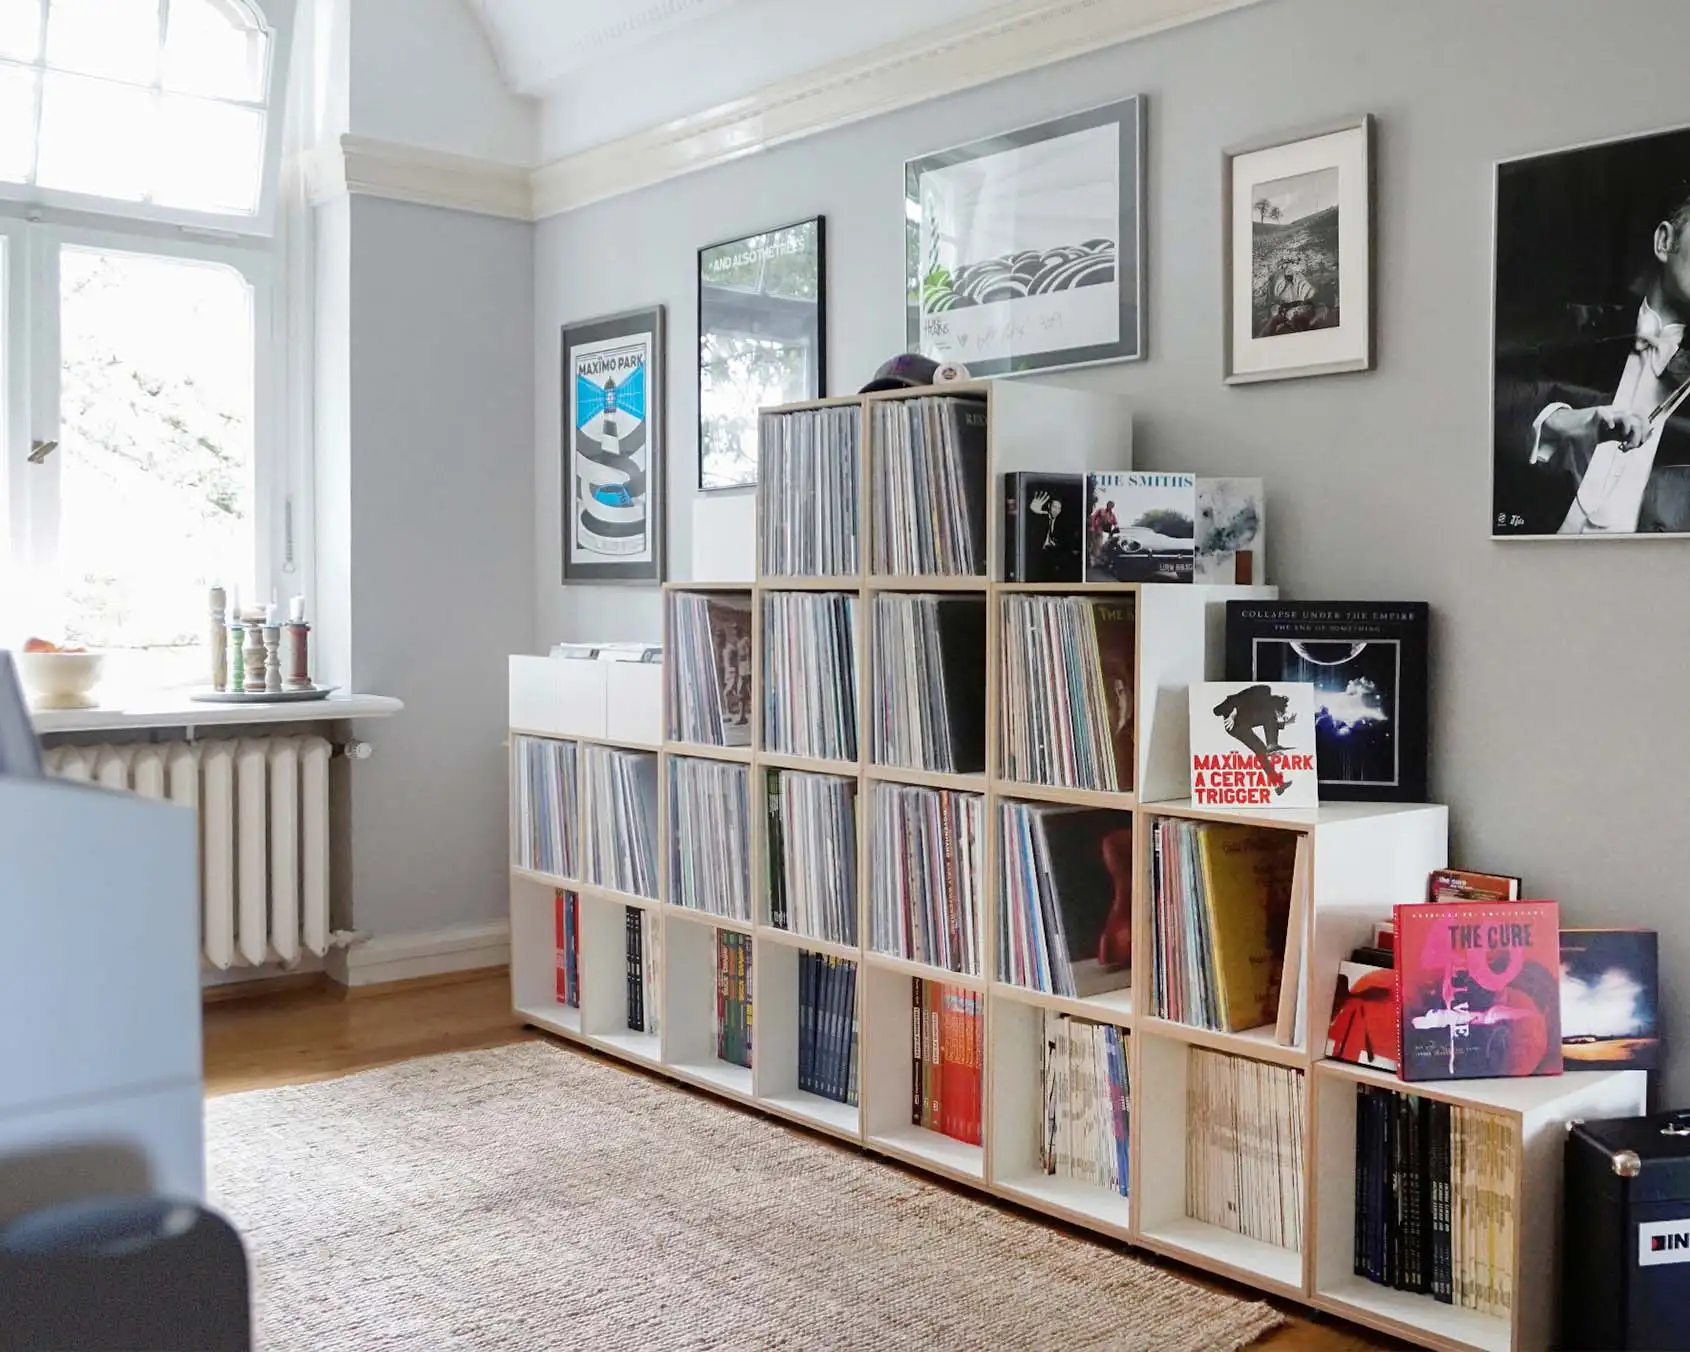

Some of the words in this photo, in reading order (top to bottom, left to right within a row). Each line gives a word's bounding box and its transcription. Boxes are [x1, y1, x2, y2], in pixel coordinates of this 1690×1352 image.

[618, 353, 643, 369] PARK
[1129, 475, 1193, 487] SMITHS
[1241, 610, 1298, 619] COLLAPSE
[1303, 611, 1341, 619] UNDER
[1346, 612, 1369, 620] THE
[1373, 612, 1415, 621] EMPIRE
[1269, 752, 1314, 770] PARK
[1195, 772, 1206, 787] A
[1195, 788, 1272, 804] TRIGGER
[1448, 925, 1483, 949] THE
[1487, 923, 1534, 949] CURE
